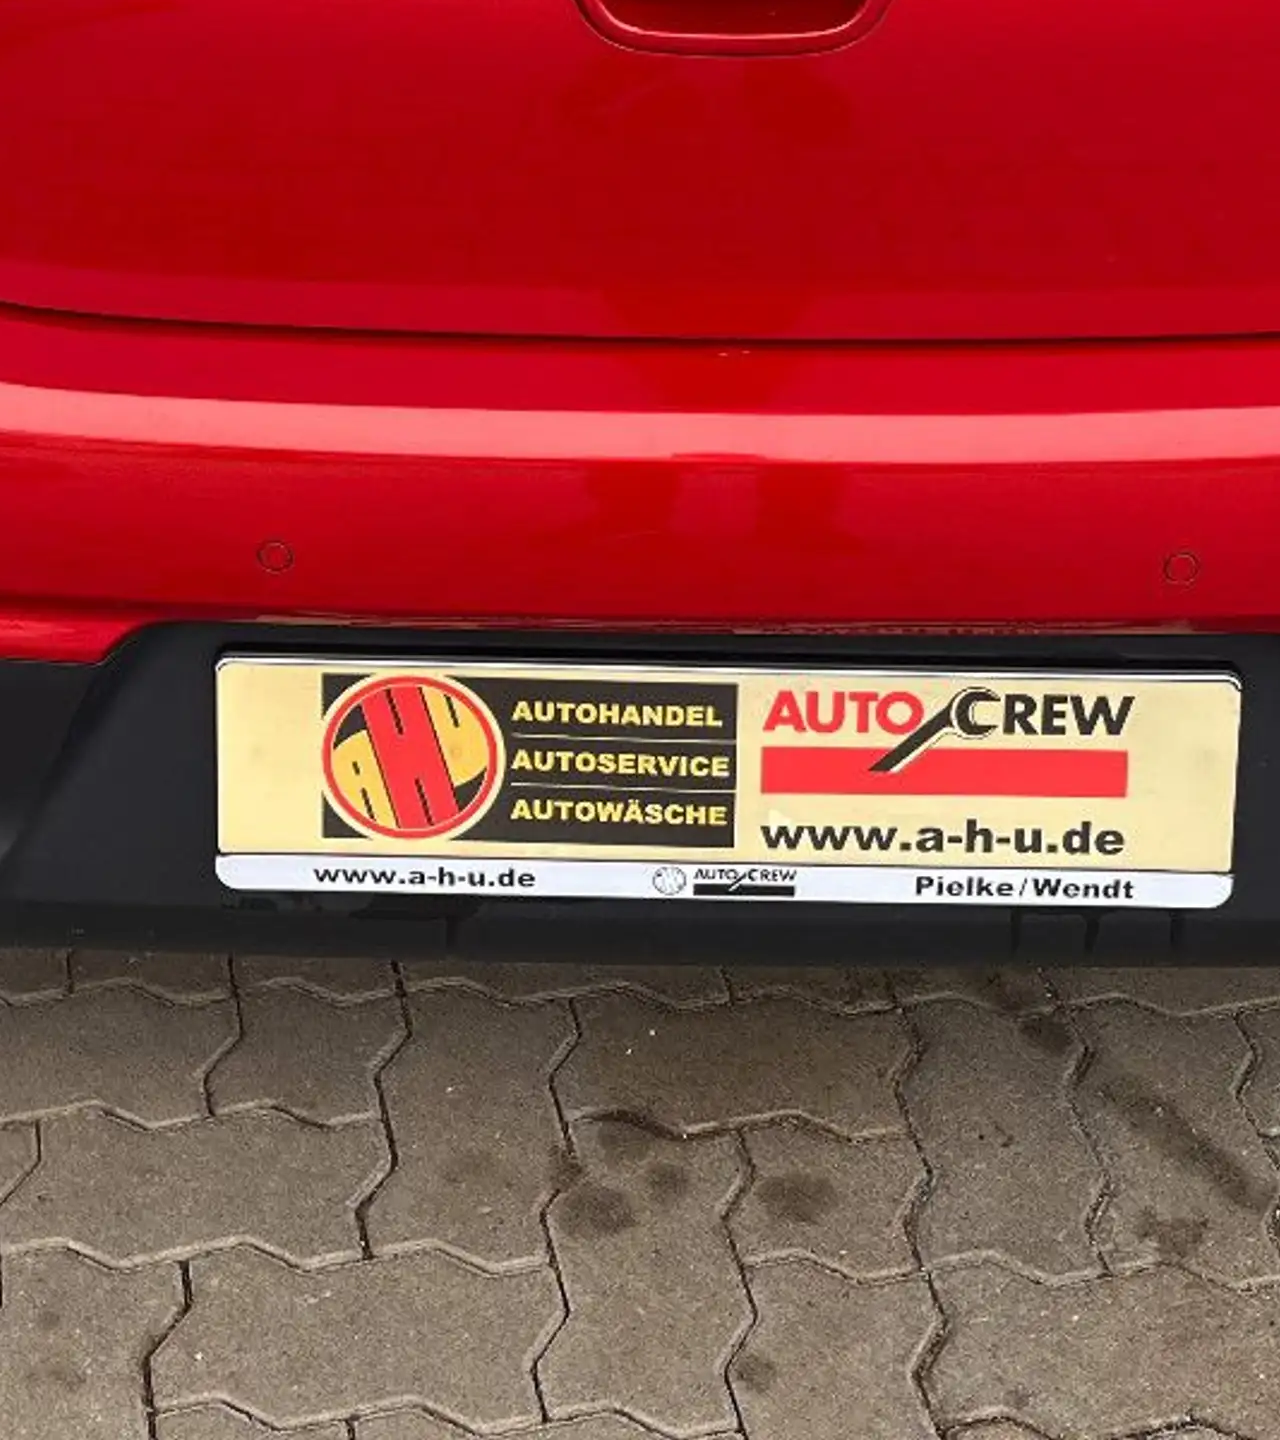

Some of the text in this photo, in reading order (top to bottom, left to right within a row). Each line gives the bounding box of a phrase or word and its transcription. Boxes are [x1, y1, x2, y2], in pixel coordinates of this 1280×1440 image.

[511, 699, 723, 728] AUTOHANDEL
[510, 748, 731, 778] AUTOSERVICE
[509, 796, 728, 826] AUTOWÄSCHE
[760, 818, 1126, 855] www.a-h-u.de
[313, 866, 537, 888] www.a-h-u.de
